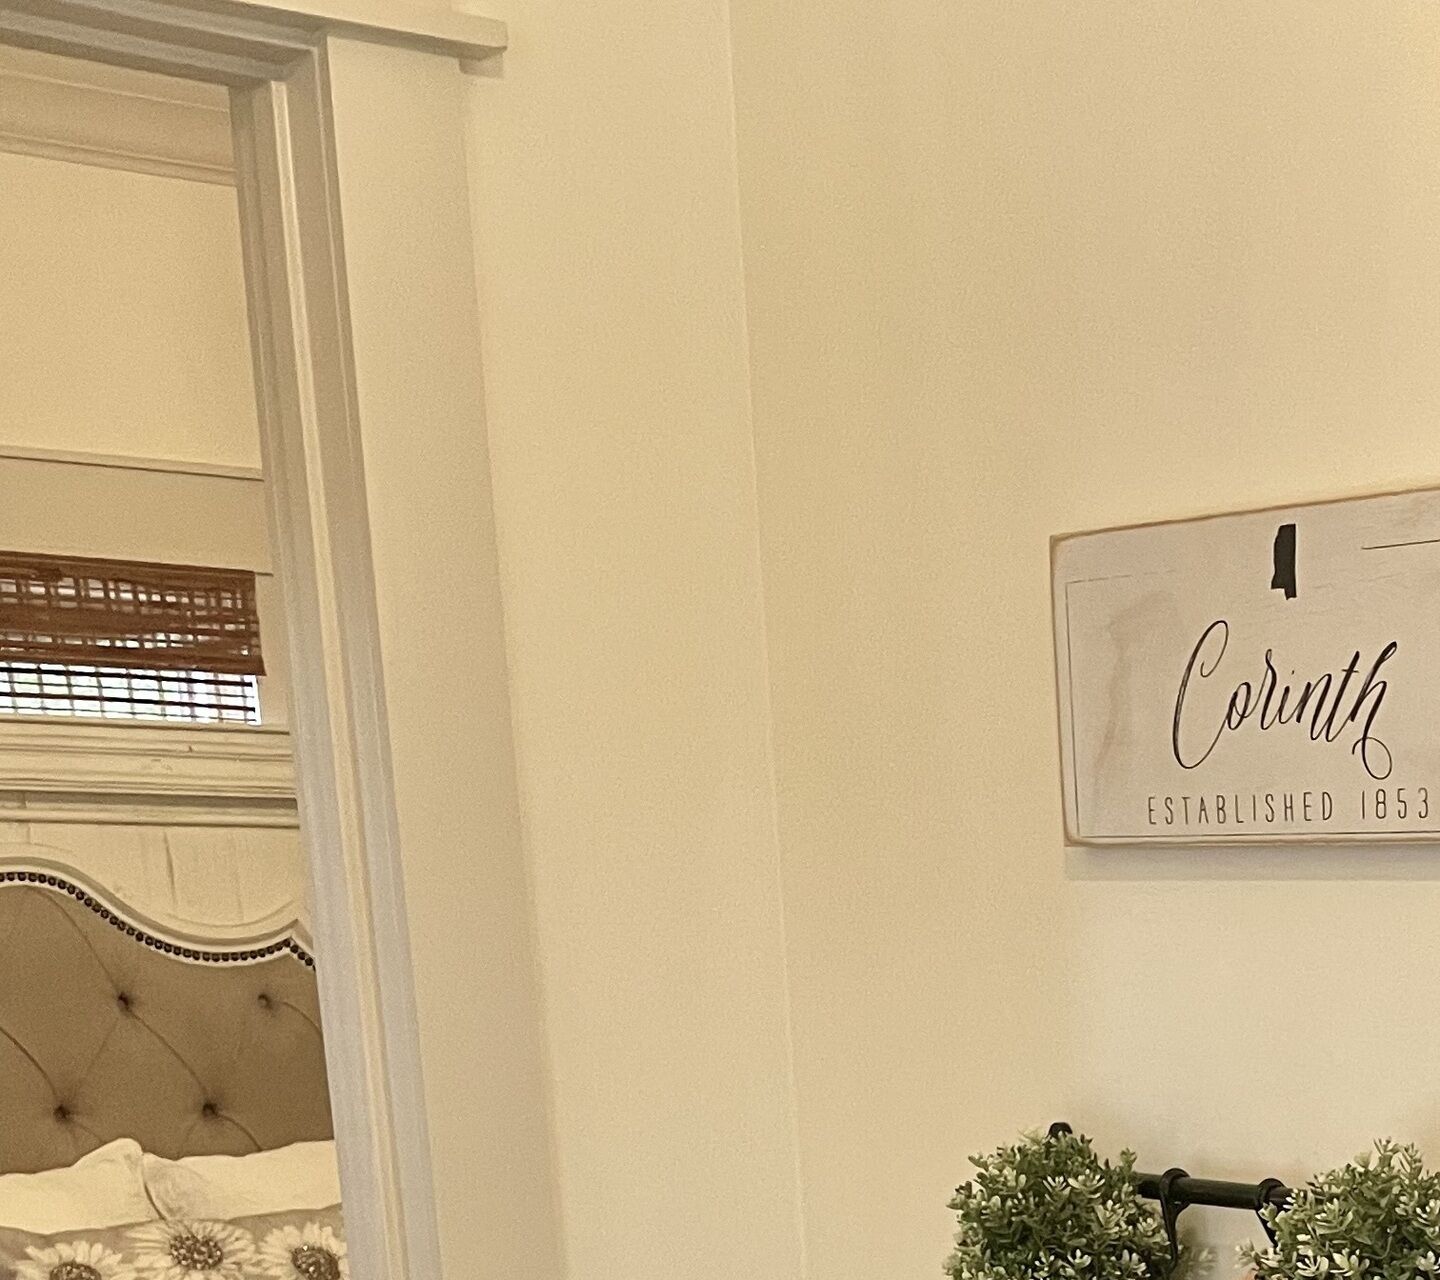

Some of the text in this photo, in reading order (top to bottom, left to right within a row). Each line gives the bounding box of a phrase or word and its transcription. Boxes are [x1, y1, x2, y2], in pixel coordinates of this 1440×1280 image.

[1172, 620, 1398, 781] Corinth
[1148, 787, 1431, 826] ESTABLISHED 1853
